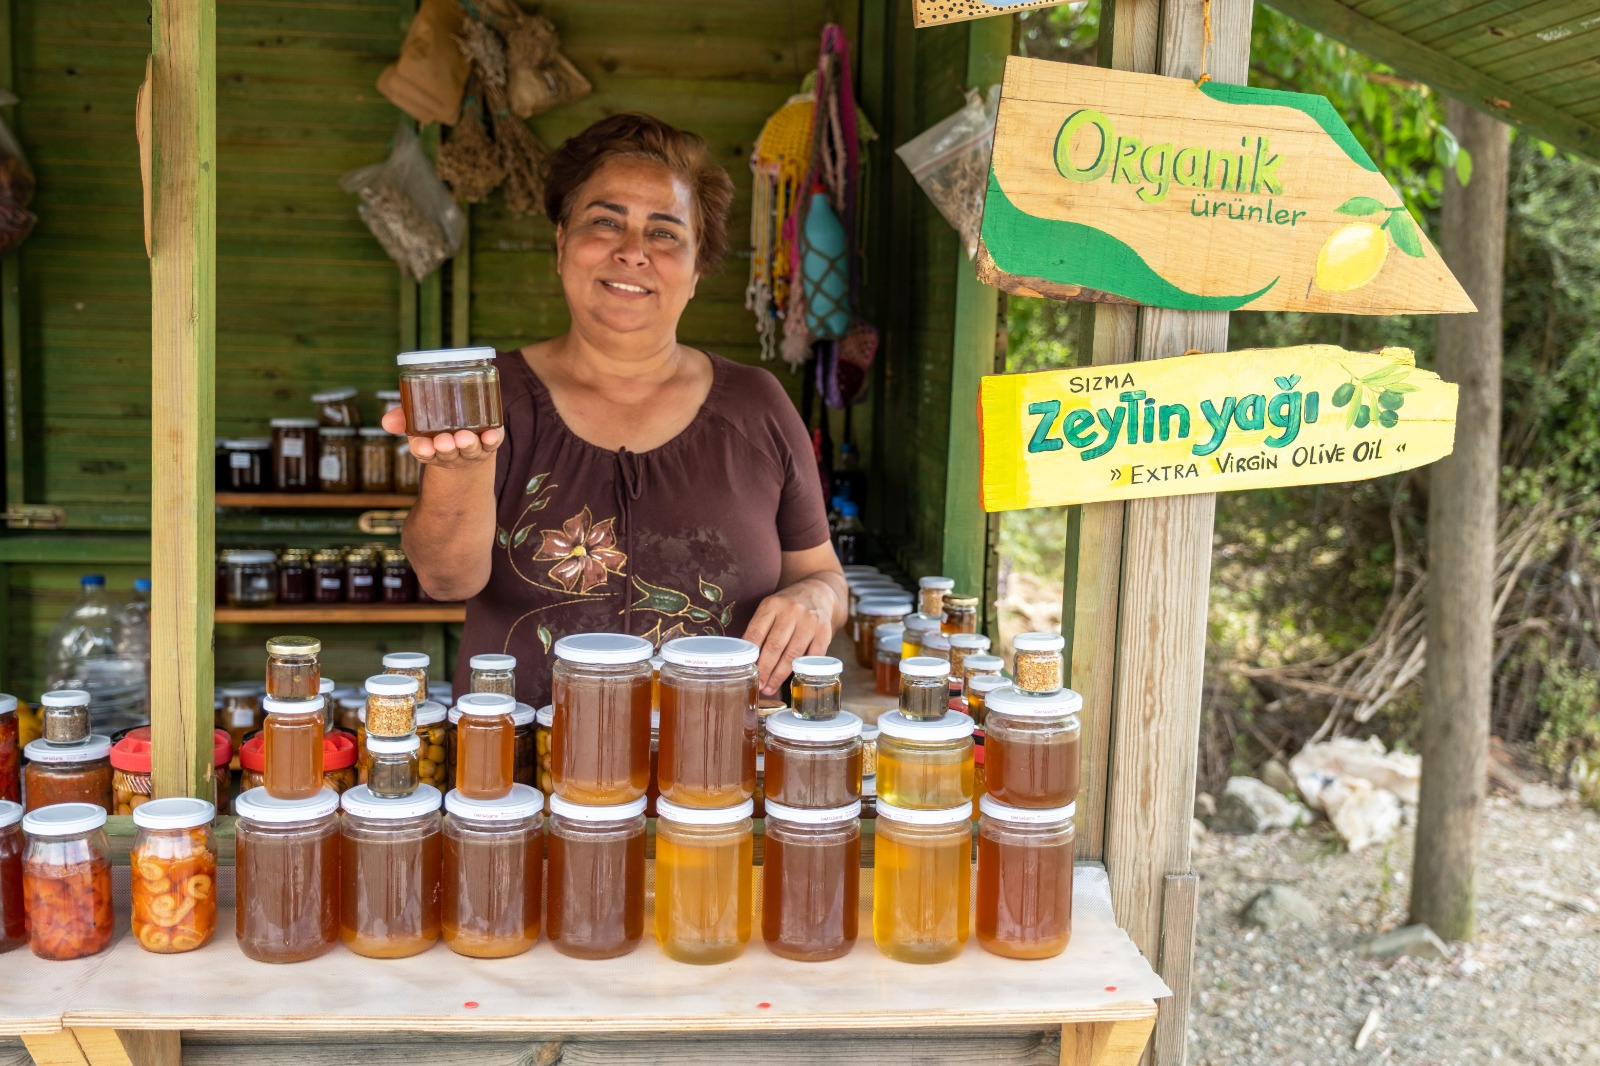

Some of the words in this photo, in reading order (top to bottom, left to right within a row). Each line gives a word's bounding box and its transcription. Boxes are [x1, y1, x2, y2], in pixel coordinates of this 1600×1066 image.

[1190, 194, 1307, 226] ürünler
[1069, 373, 1135, 393] SIZMA
[1191, 374, 1319, 456] yağı
[1131, 464, 1199, 484] EXTRA
